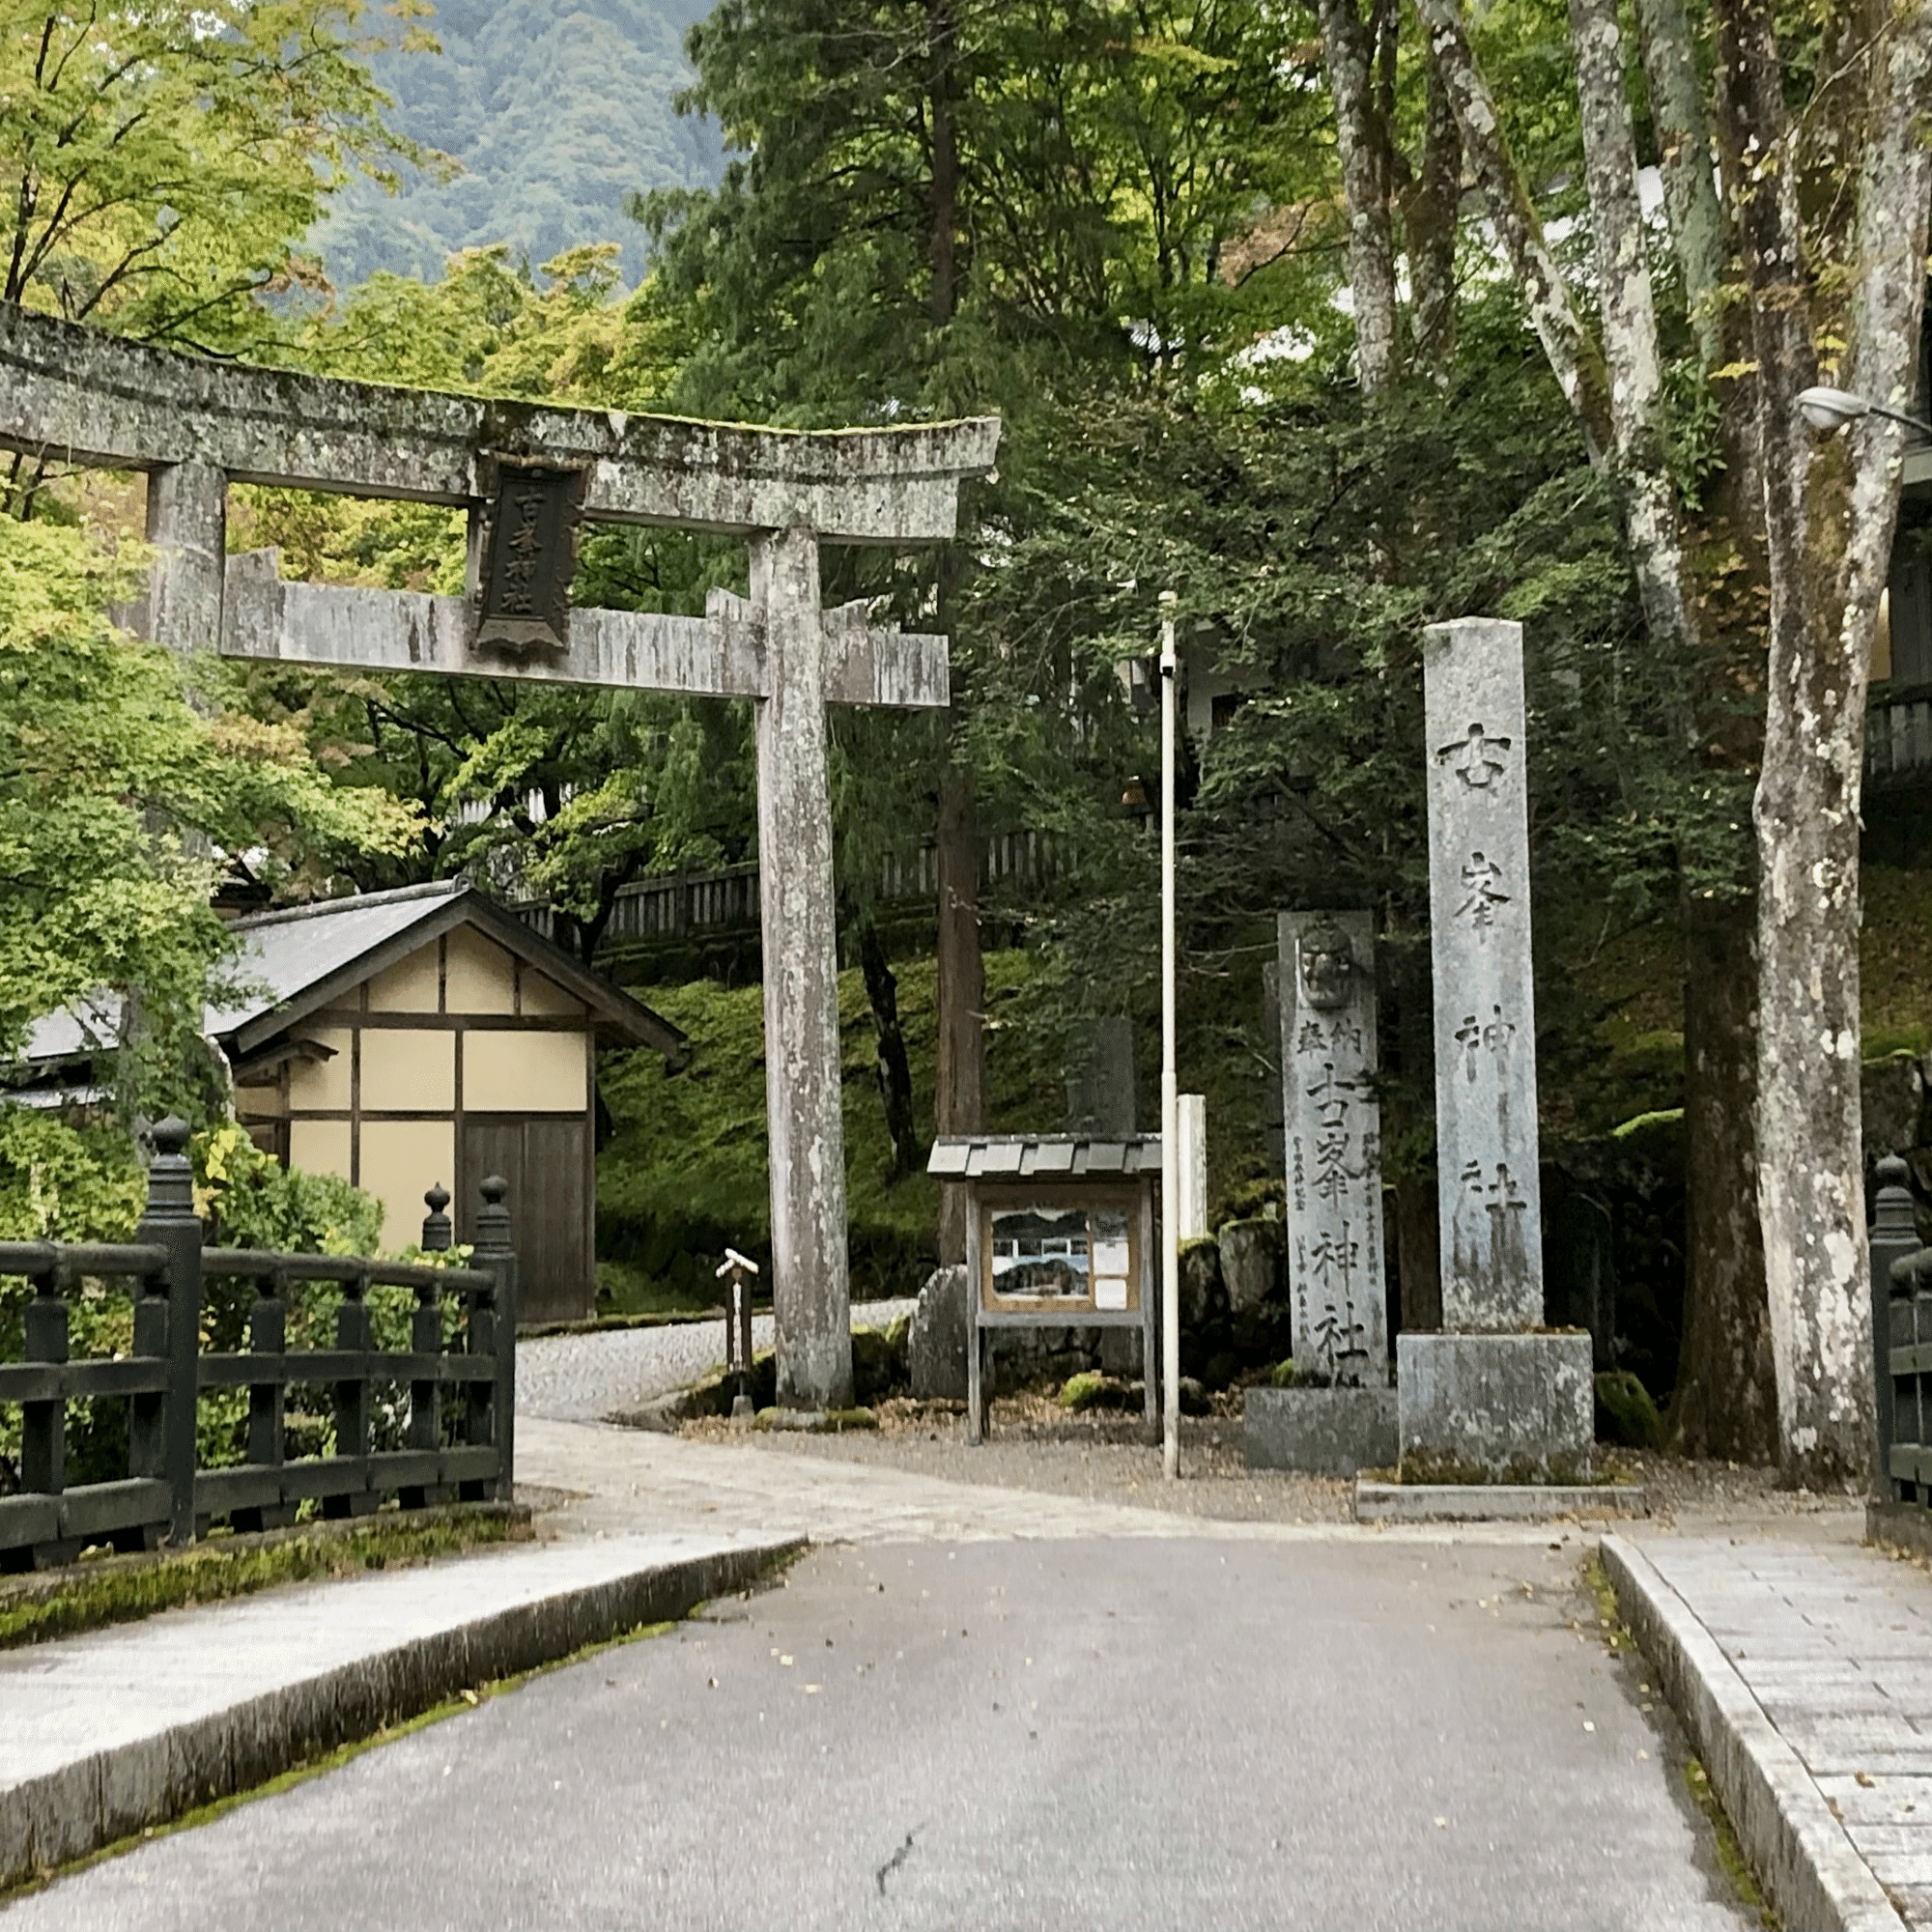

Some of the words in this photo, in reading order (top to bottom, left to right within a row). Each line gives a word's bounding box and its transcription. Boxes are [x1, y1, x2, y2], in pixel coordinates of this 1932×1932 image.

[499, 489, 546, 612] 古峯神社
[1437, 723, 1527, 1229] 古峯神社
[1306, 1062, 1370, 1372] 古峯神社
